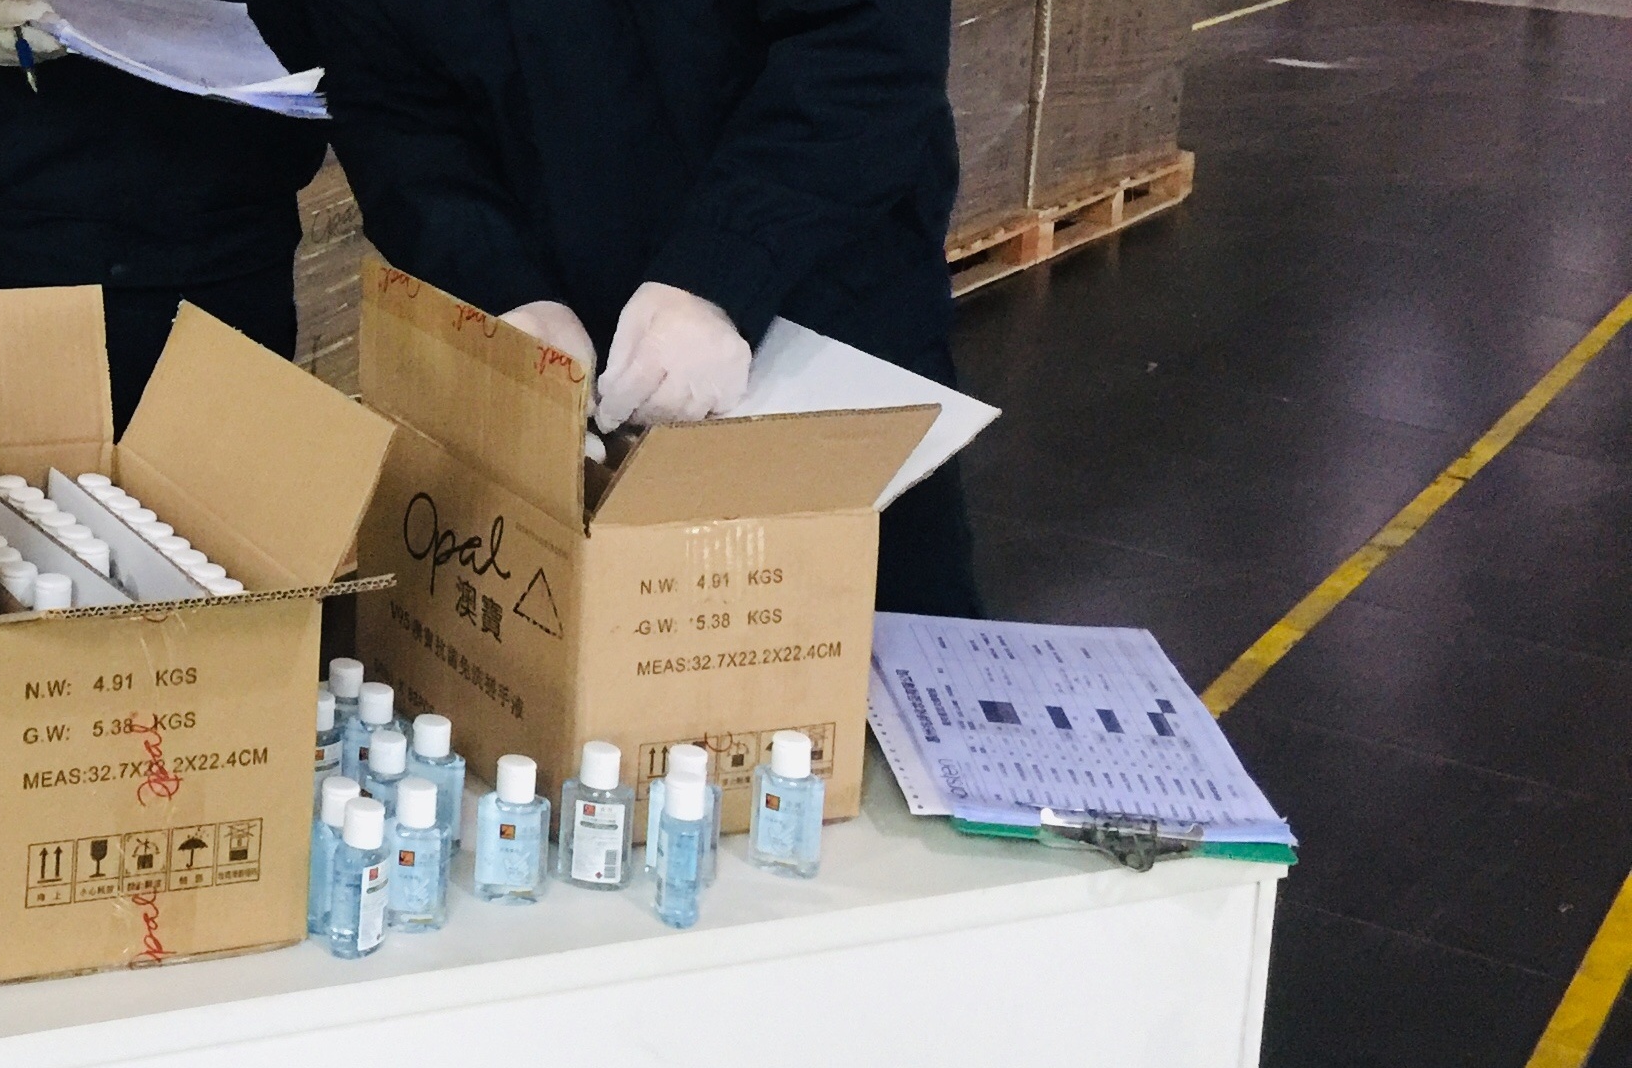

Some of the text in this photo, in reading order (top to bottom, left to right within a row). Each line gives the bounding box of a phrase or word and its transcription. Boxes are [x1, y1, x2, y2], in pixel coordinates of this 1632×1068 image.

[403, 492, 512, 597] Opal
[696, 572, 730, 590] 4.91
[747, 567, 784, 586] KGS
[695, 613, 731, 631] 5.38
[747, 608, 784, 626] KGS
[636, 640, 843, 676] MEAS:32.7X22.2X22.4CM
[24, 666, 198, 701] N.W: 4.91 KGS
[22, 710, 197, 745] G.W: 5.38 KGS
